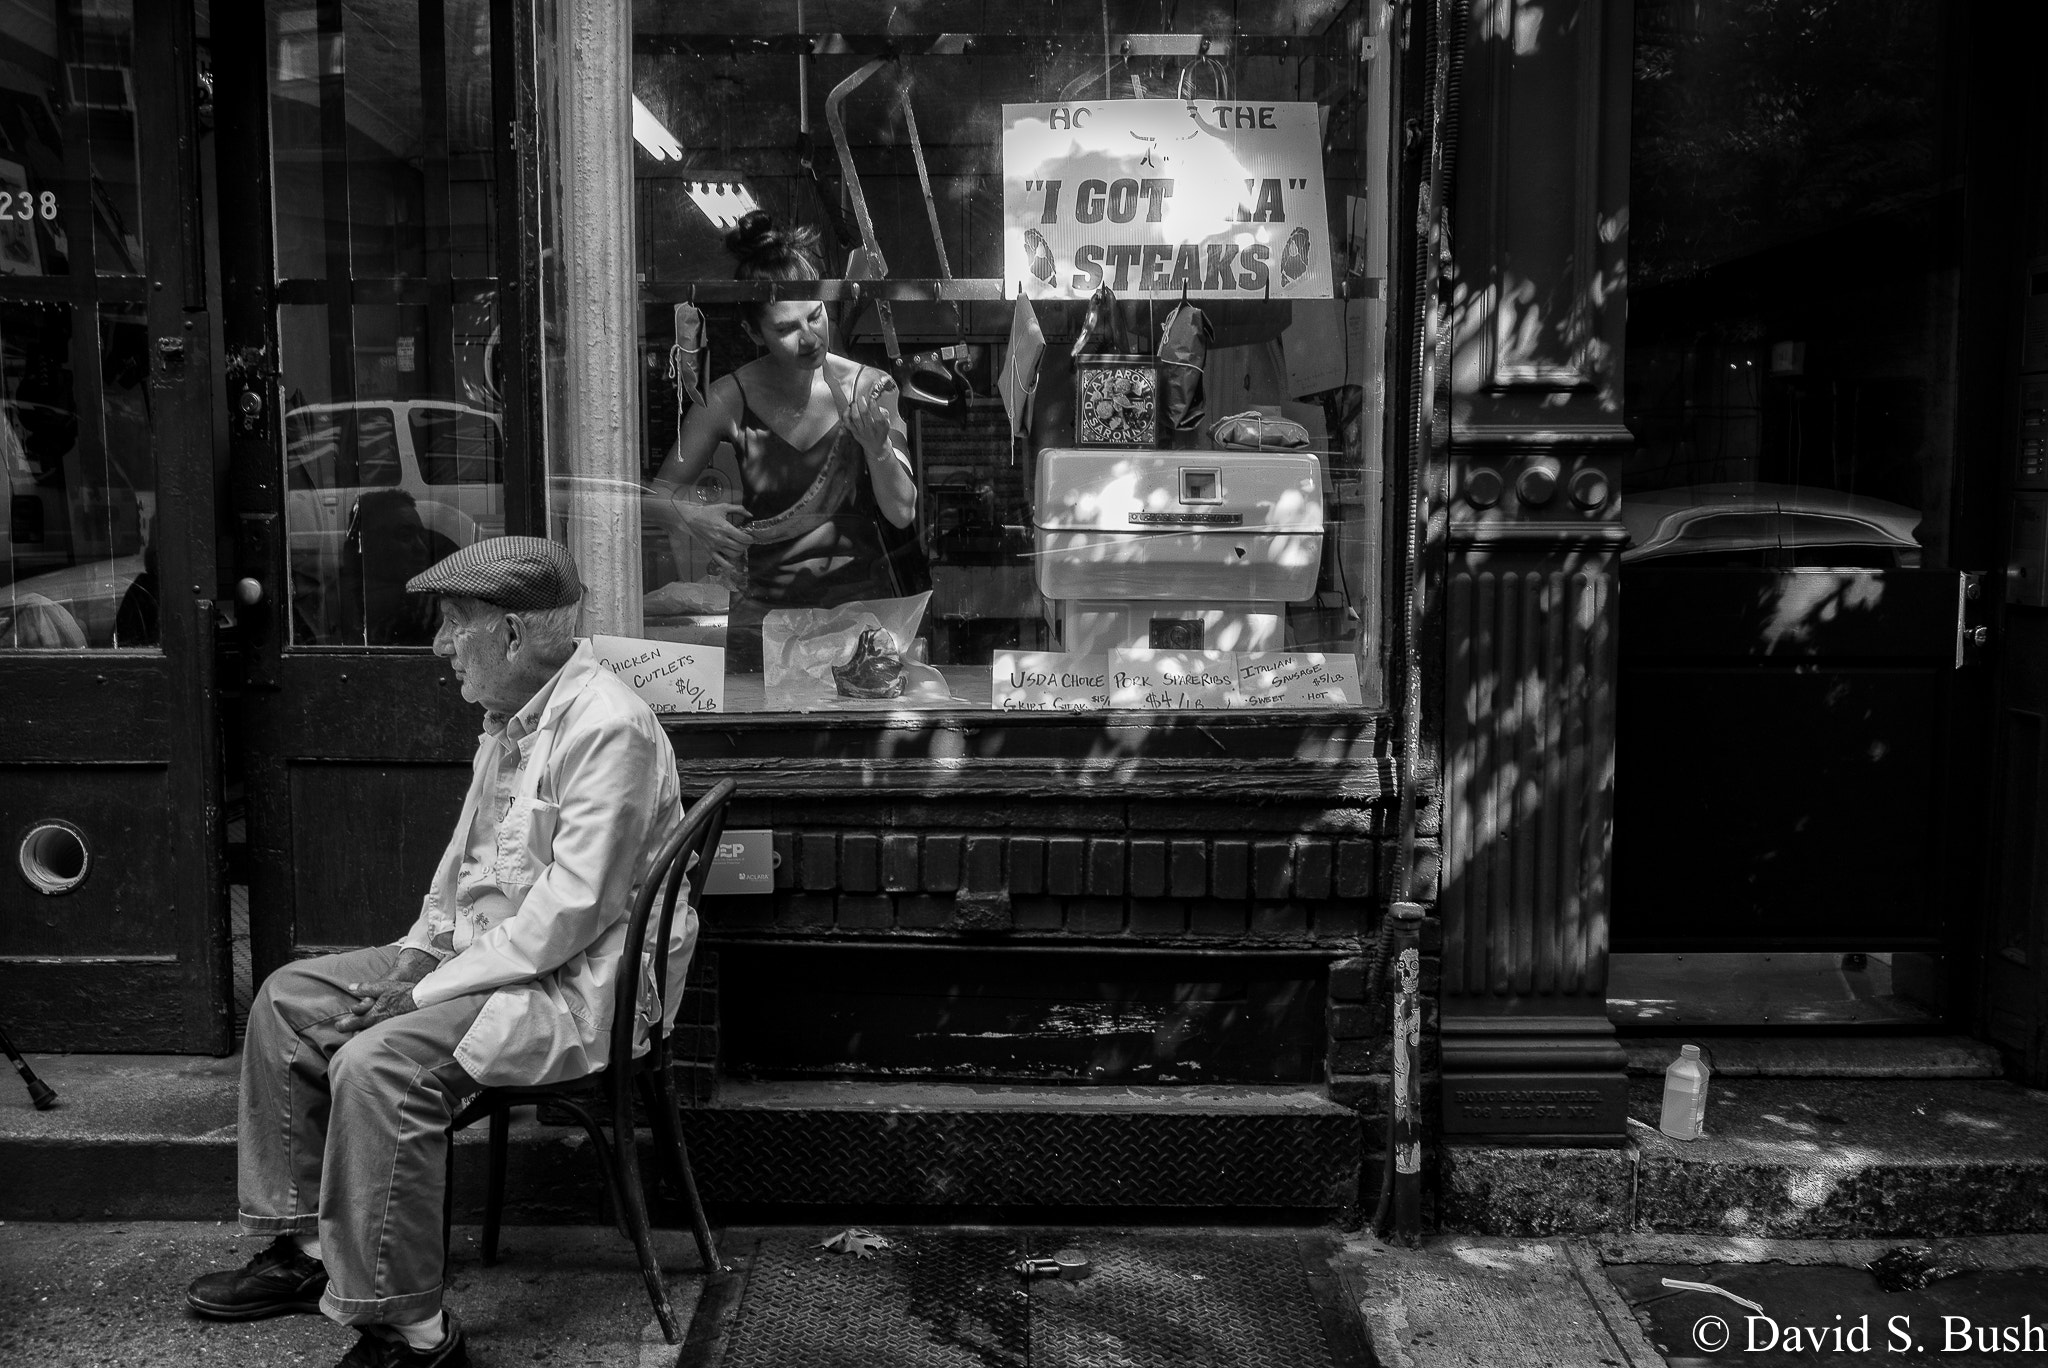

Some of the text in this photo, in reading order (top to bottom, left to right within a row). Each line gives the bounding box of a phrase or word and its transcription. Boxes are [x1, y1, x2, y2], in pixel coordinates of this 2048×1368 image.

[1212, 106, 1277, 130] THE
[0, 190, 57, 220] 238
[1025, 179, 1062, 224] "I
[1072, 244, 1270, 291] STEAKS
[633, 655, 695, 689] CUTLETS
[1010, 671, 1105, 689] USDA CHOICE
[1113, 671, 1153, 689] PORK
[1240, 657, 1292, 680] ITALIAN
[1271, 663, 1322, 688] SAUSAGE
[649, 702, 677, 712] RDER
[1307, 691, 1328, 701] HOT
